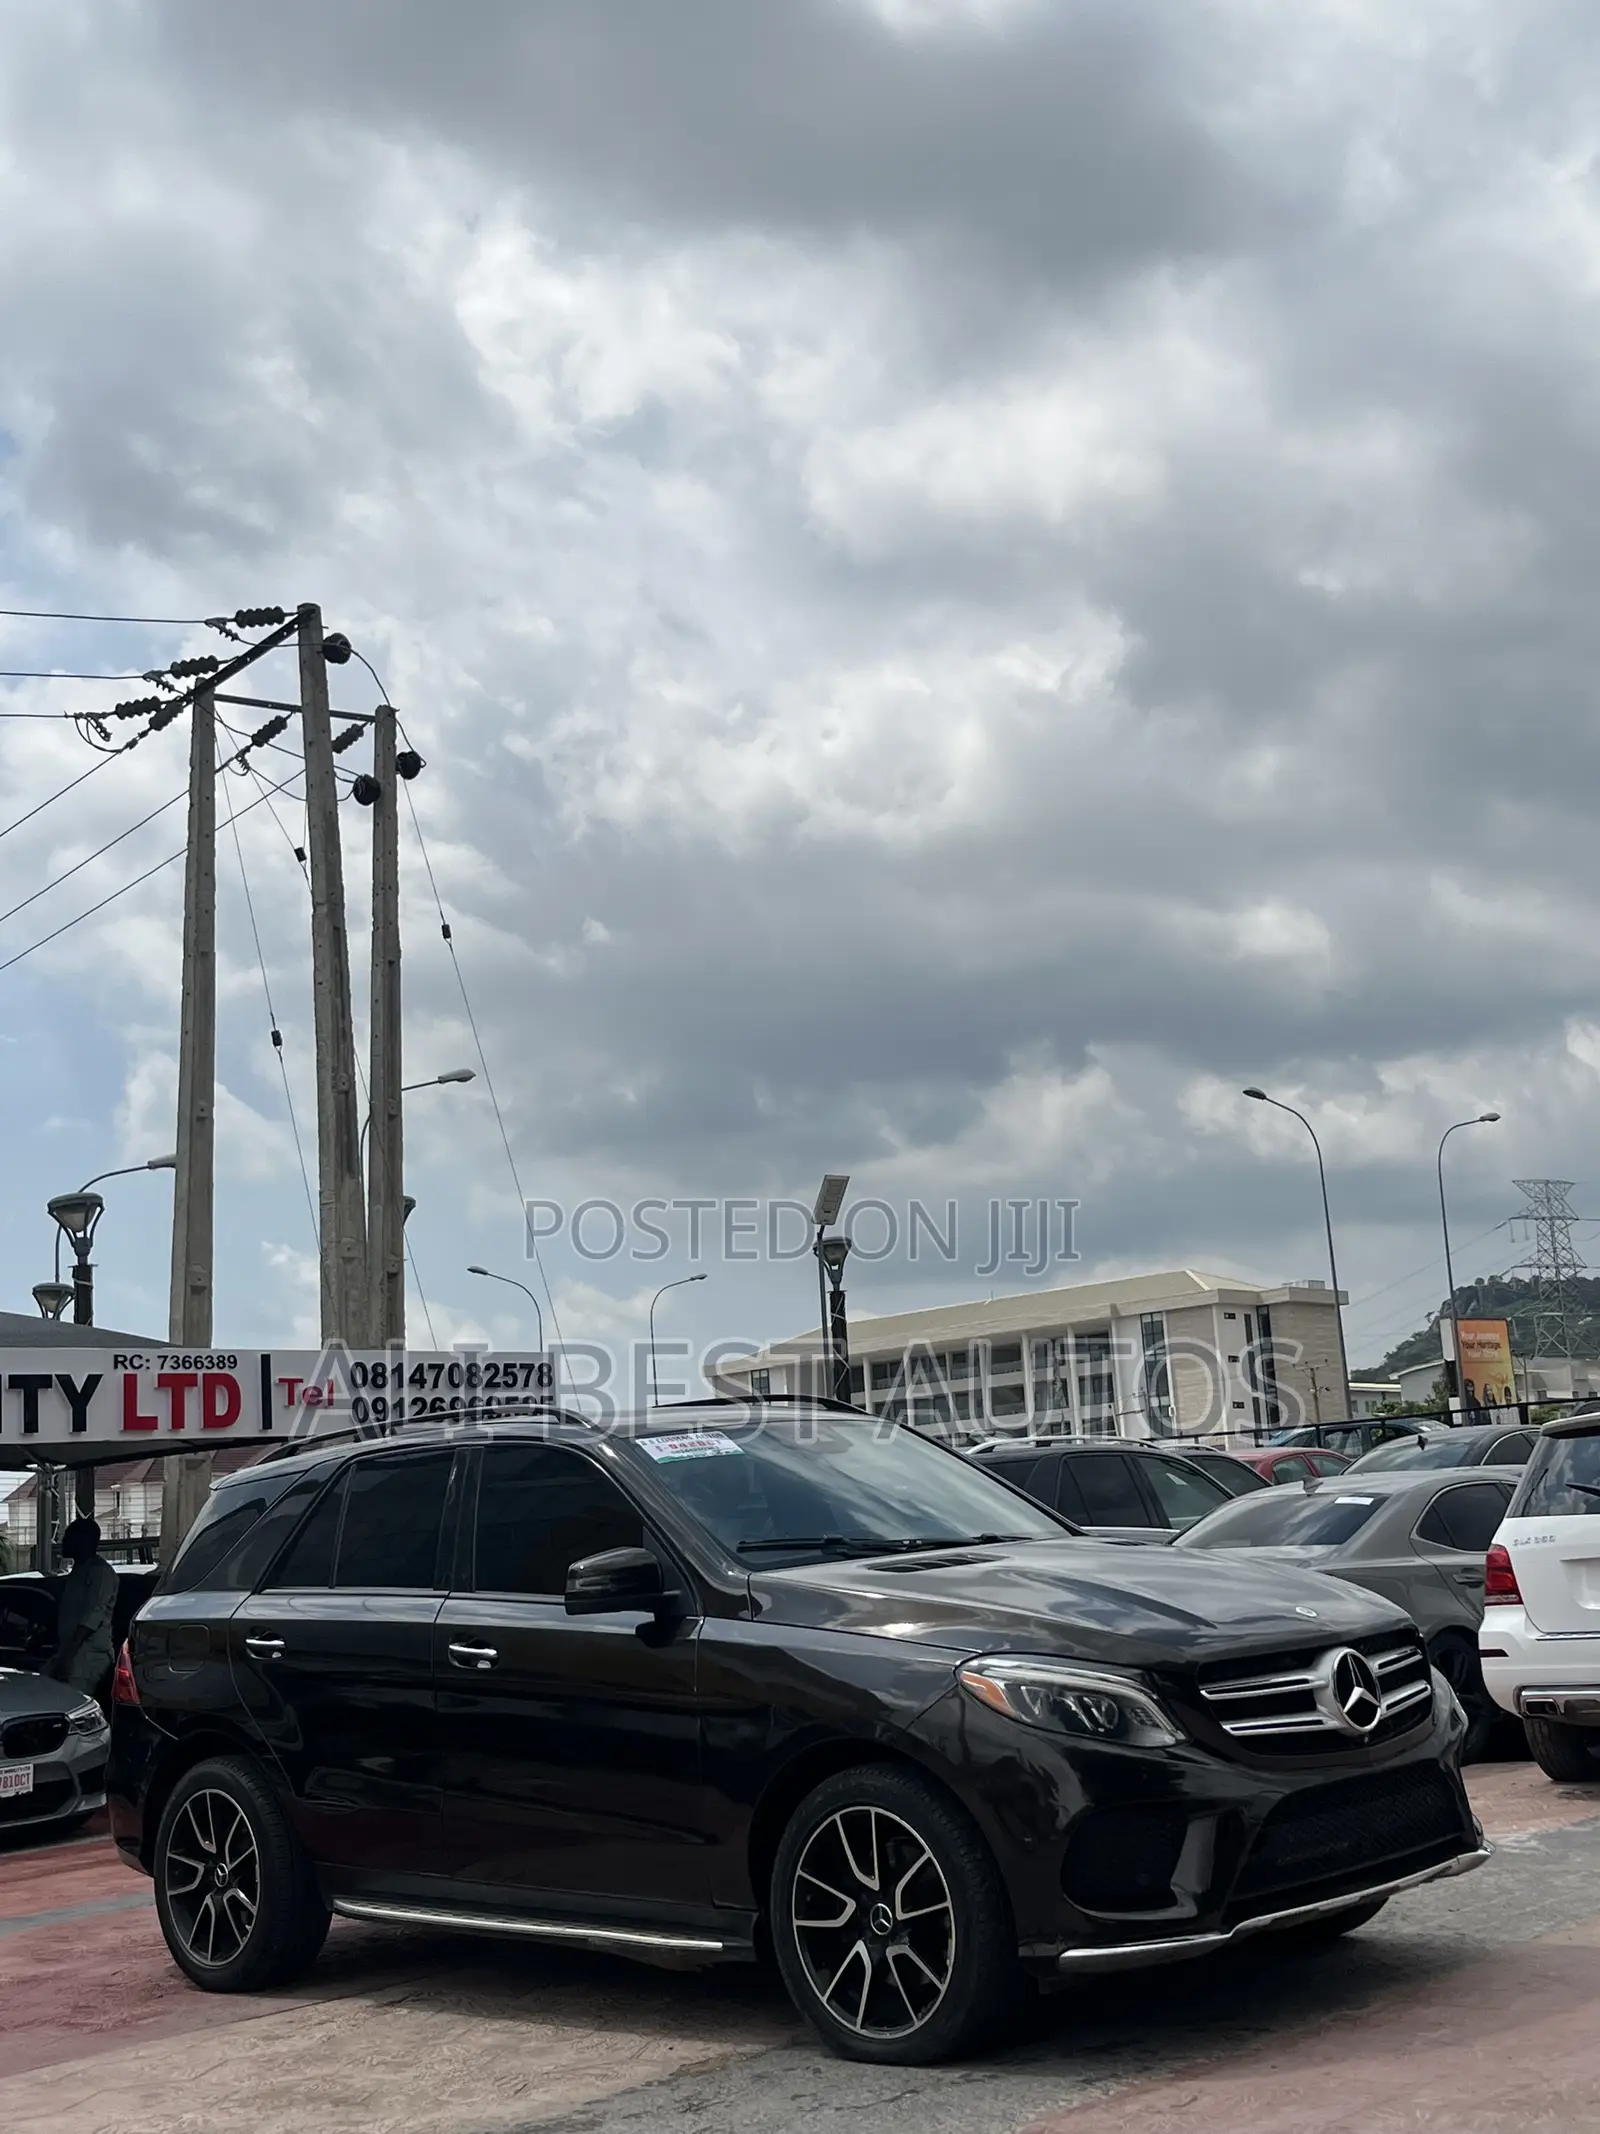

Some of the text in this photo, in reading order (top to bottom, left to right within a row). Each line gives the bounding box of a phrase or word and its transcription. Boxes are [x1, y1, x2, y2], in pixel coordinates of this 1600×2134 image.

[113, 1354, 238, 1370] RC: 7366389
[278, 1361, 554, 1407] Tel 08147082578
[0, 1372, 242, 1434] TY LTD
